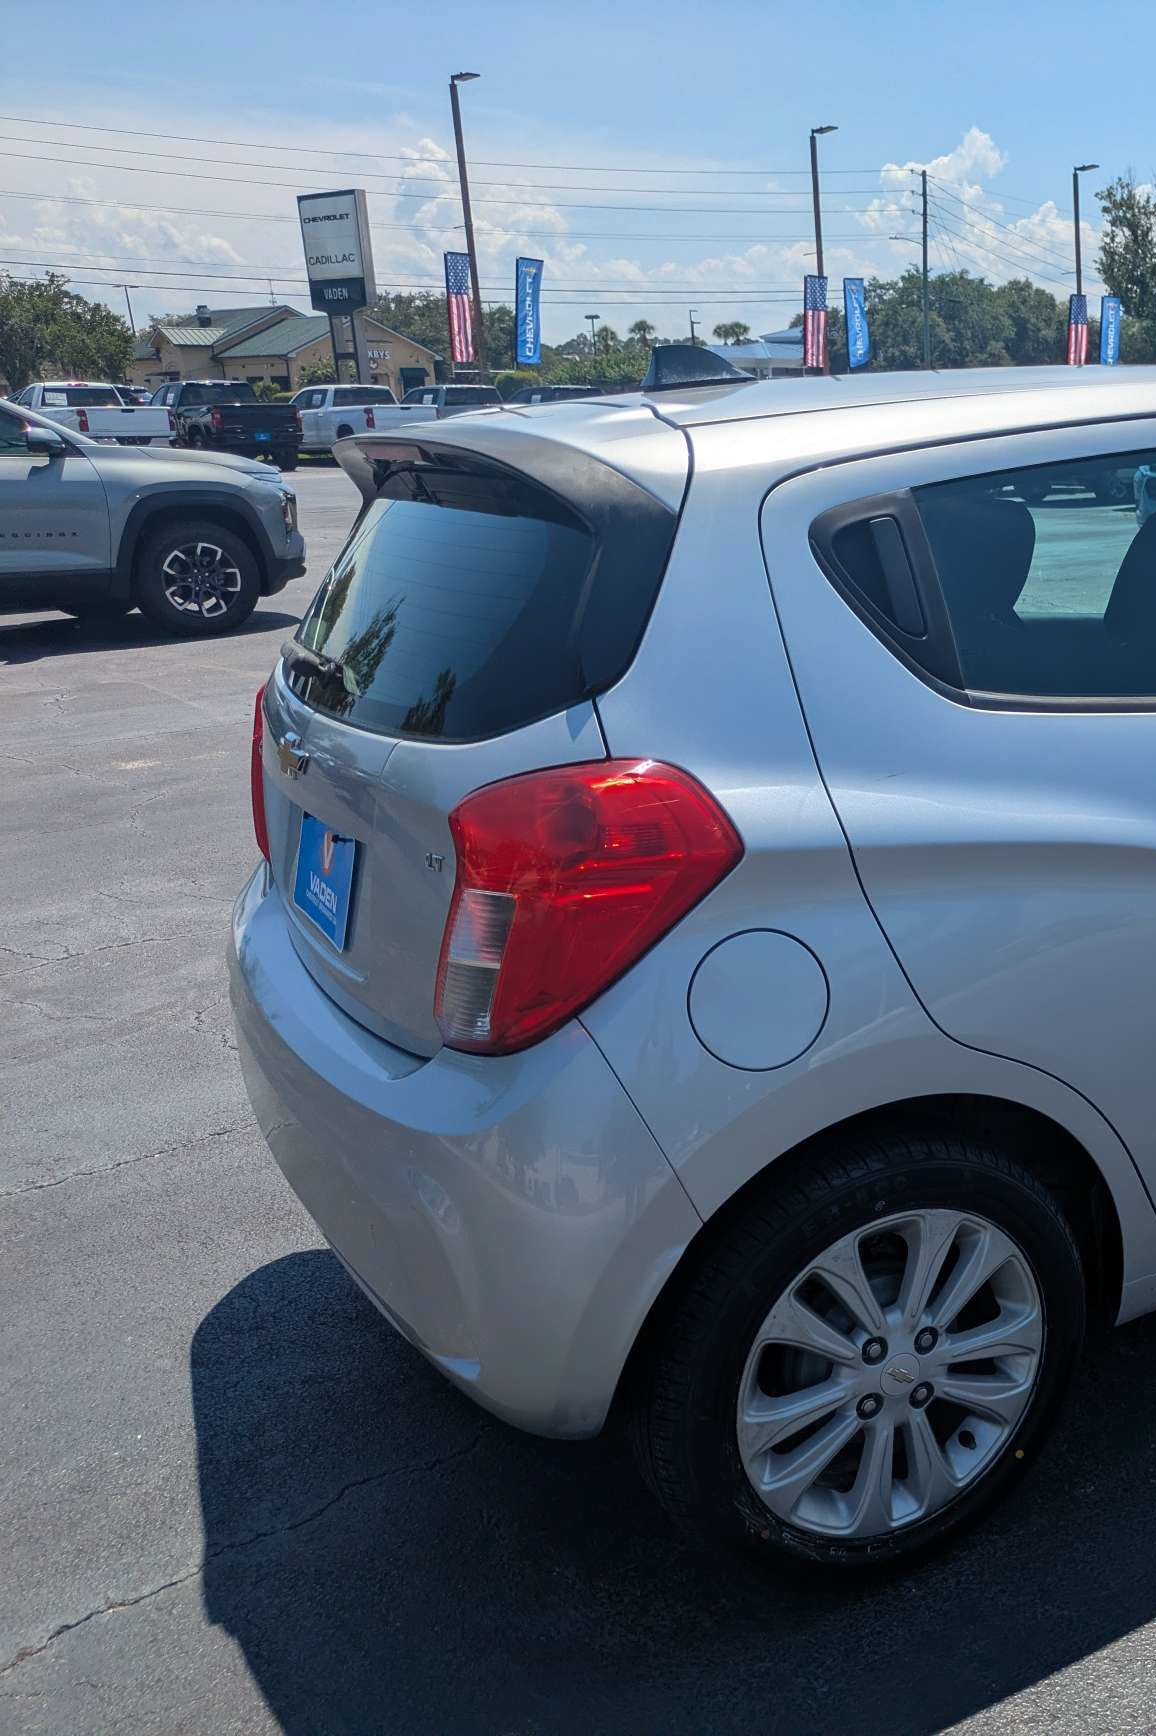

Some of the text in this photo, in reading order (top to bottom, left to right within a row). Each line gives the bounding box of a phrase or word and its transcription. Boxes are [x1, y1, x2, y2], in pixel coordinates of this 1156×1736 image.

[303, 213, 350, 224] CHEVROLET
[308, 253, 355, 265] CADILLAC
[323, 287, 348, 300] VADEN
[367, 350, 391, 360] XBYS
[309, 870, 338, 915] VADEN
